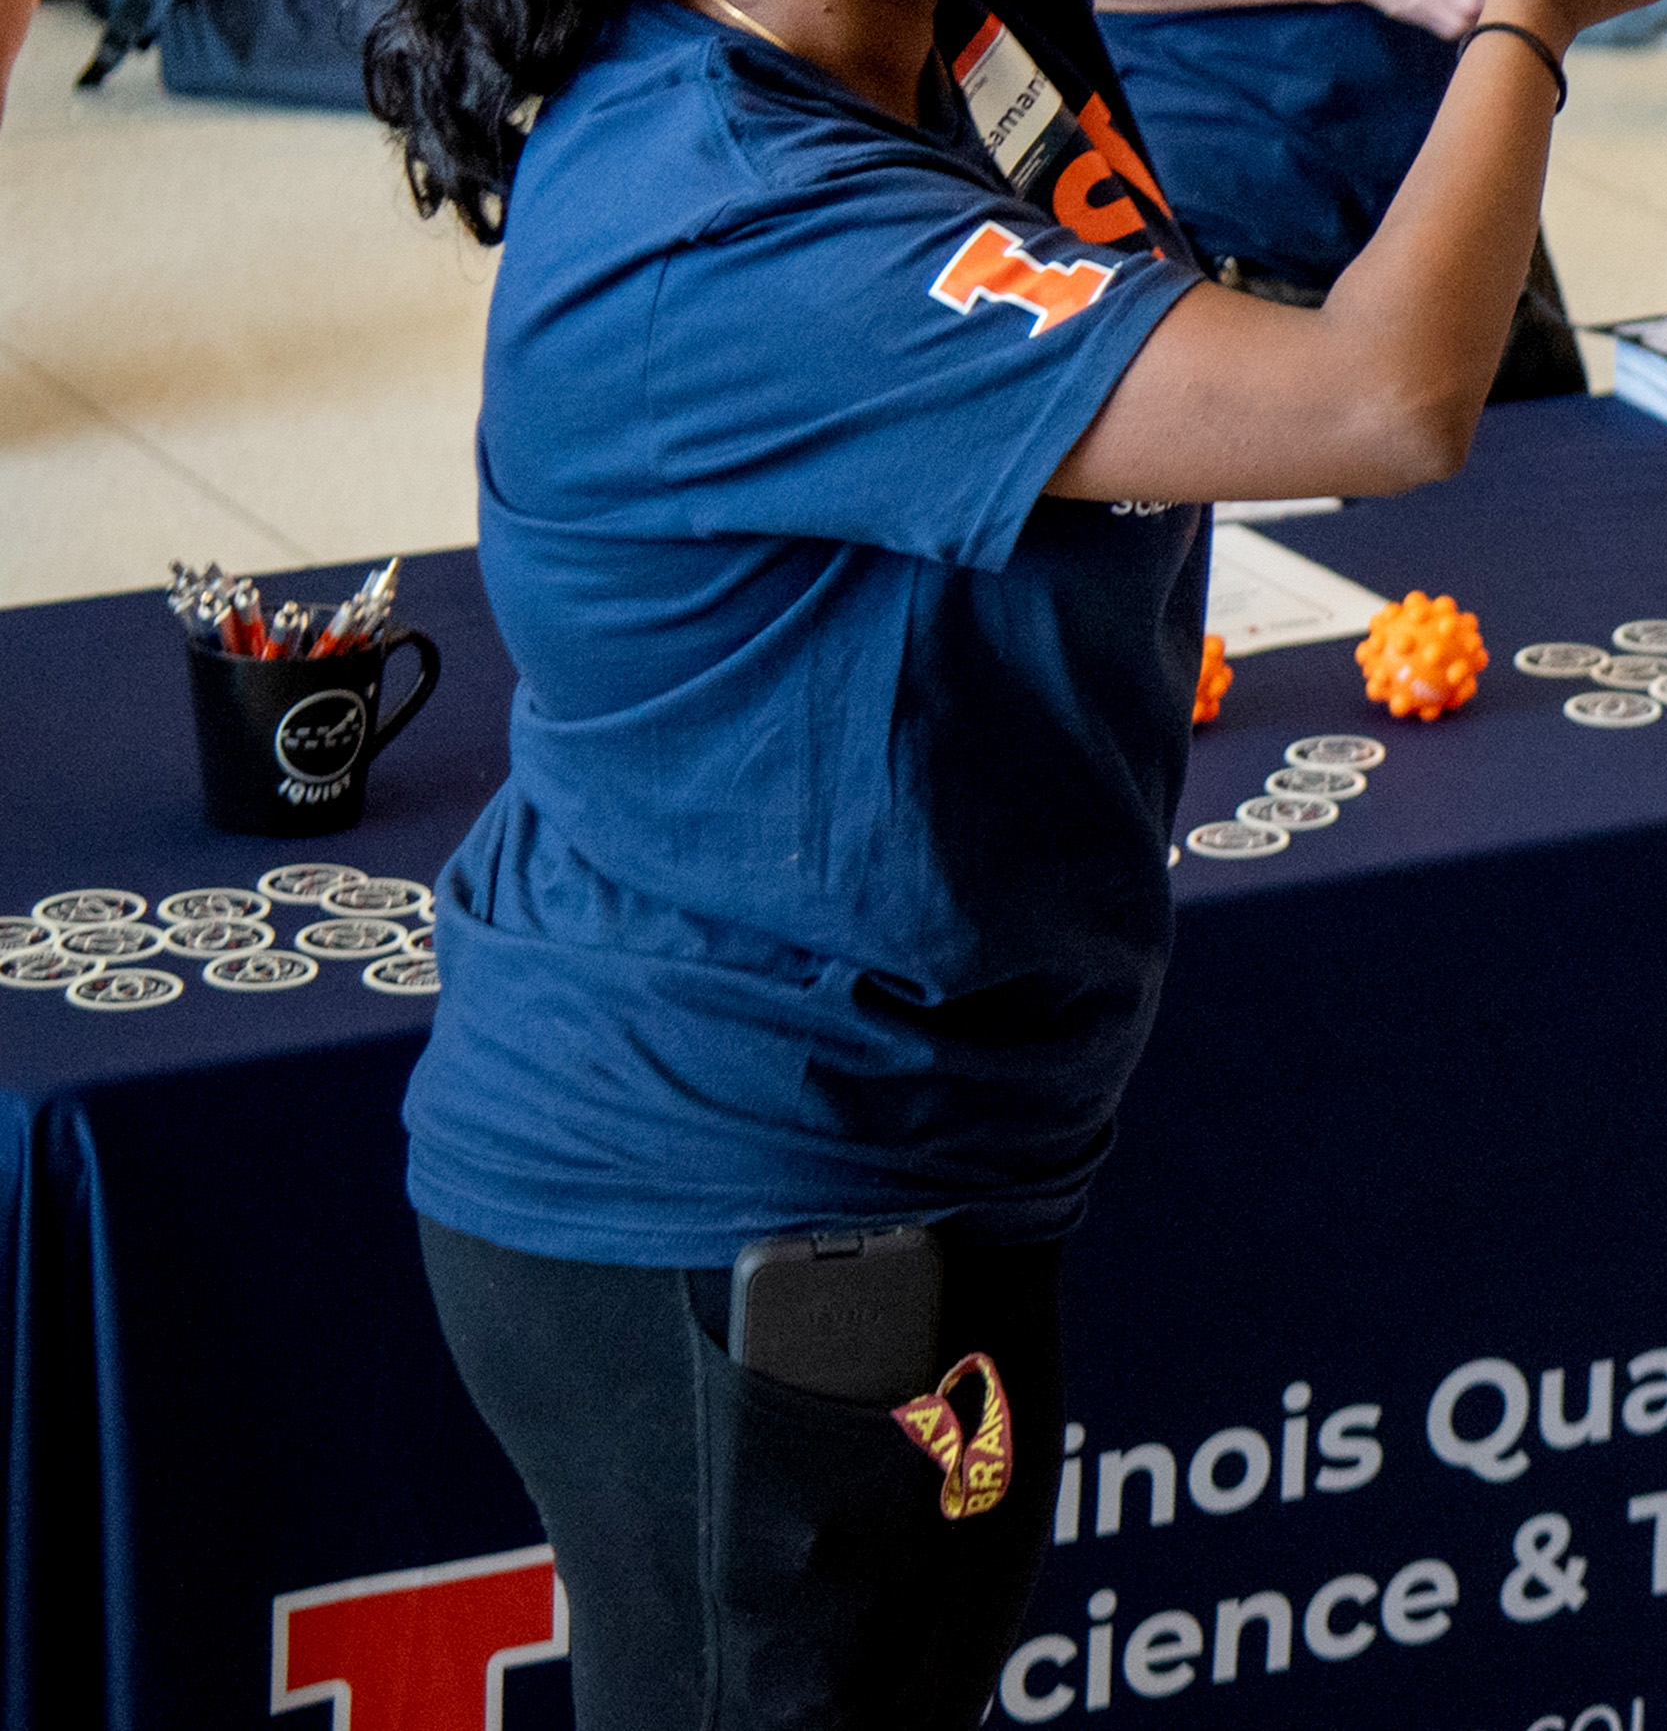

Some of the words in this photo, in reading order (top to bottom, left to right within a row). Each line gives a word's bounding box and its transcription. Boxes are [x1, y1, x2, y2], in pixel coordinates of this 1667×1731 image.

[1053, 1380, 1384, 1547] inois
[999, 1557, 1459, 1725] cience
[1500, 1512, 1588, 1623] &
